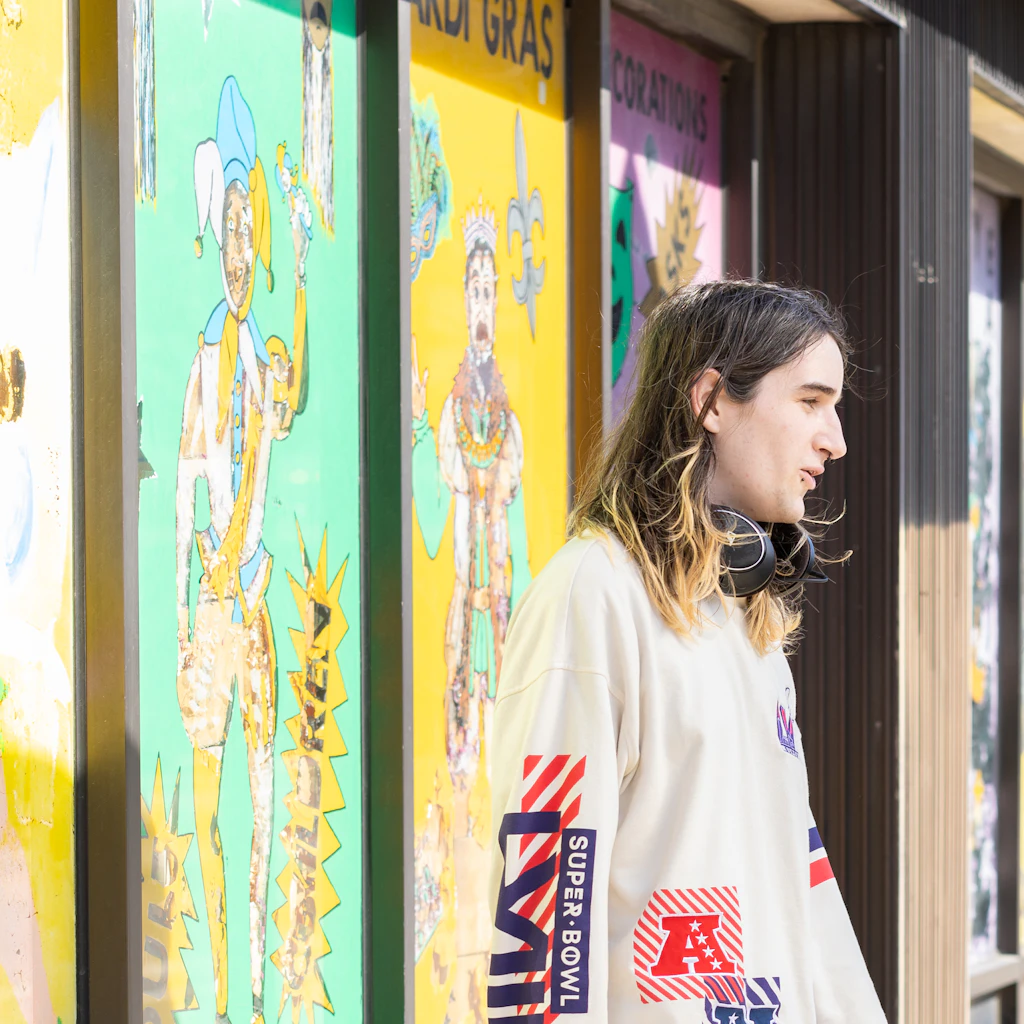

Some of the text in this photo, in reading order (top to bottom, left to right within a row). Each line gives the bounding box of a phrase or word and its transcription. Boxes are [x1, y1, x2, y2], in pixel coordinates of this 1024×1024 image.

[483, 0, 554, 80] GRAS
[560, 835, 589, 1007] SUPER BOWL
[647, 911, 738, 979] A
